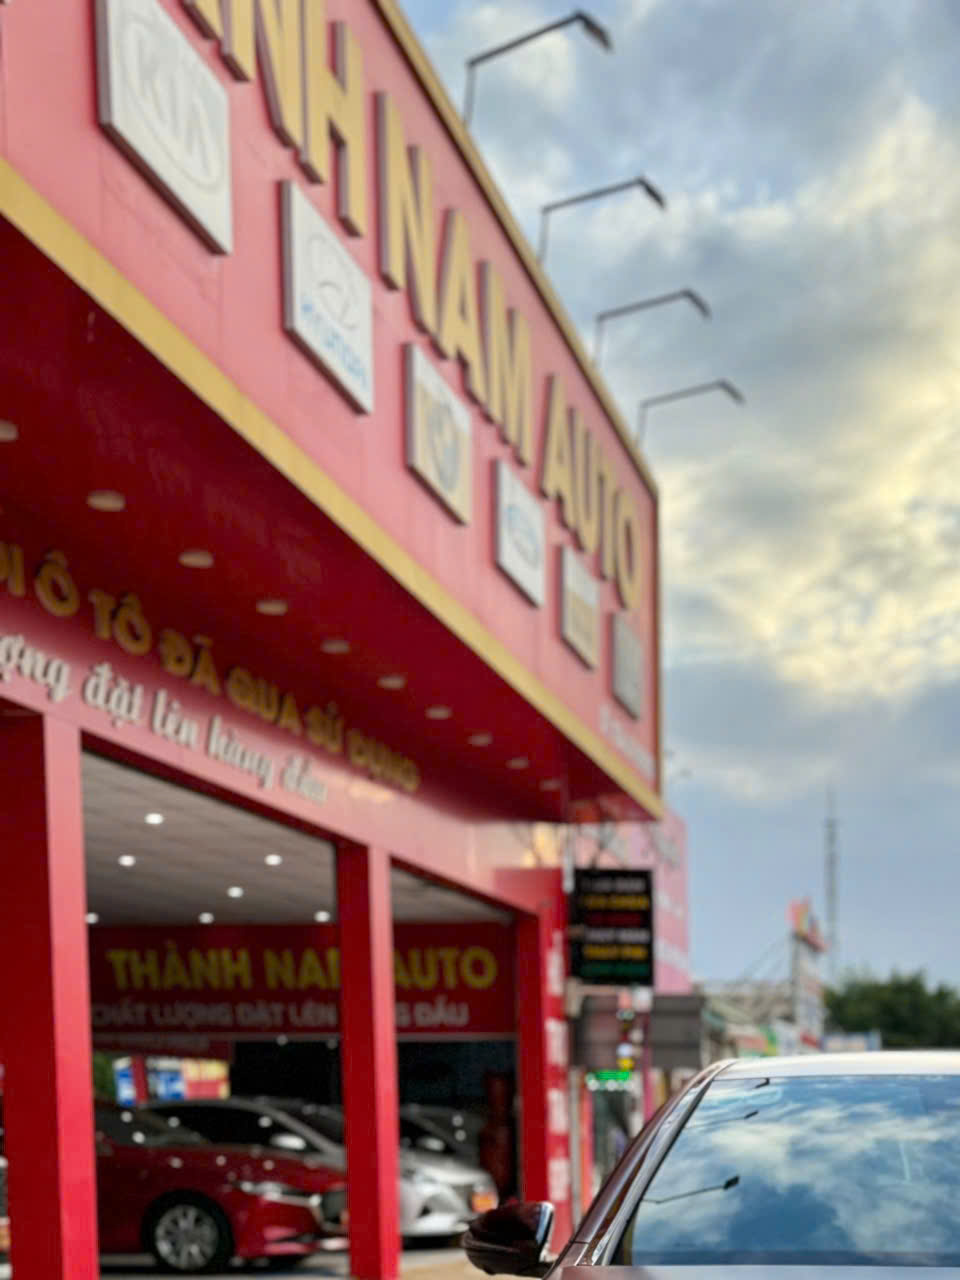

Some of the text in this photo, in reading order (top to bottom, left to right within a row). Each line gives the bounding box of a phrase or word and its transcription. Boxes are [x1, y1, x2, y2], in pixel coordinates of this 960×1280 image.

[180, 0, 366, 238] NH
[373, 90, 534, 470] NAM
[541, 373, 642, 612] AUTO
[89, 590, 152, 655] TÔ
[106, 940, 252, 990] THÀNH
